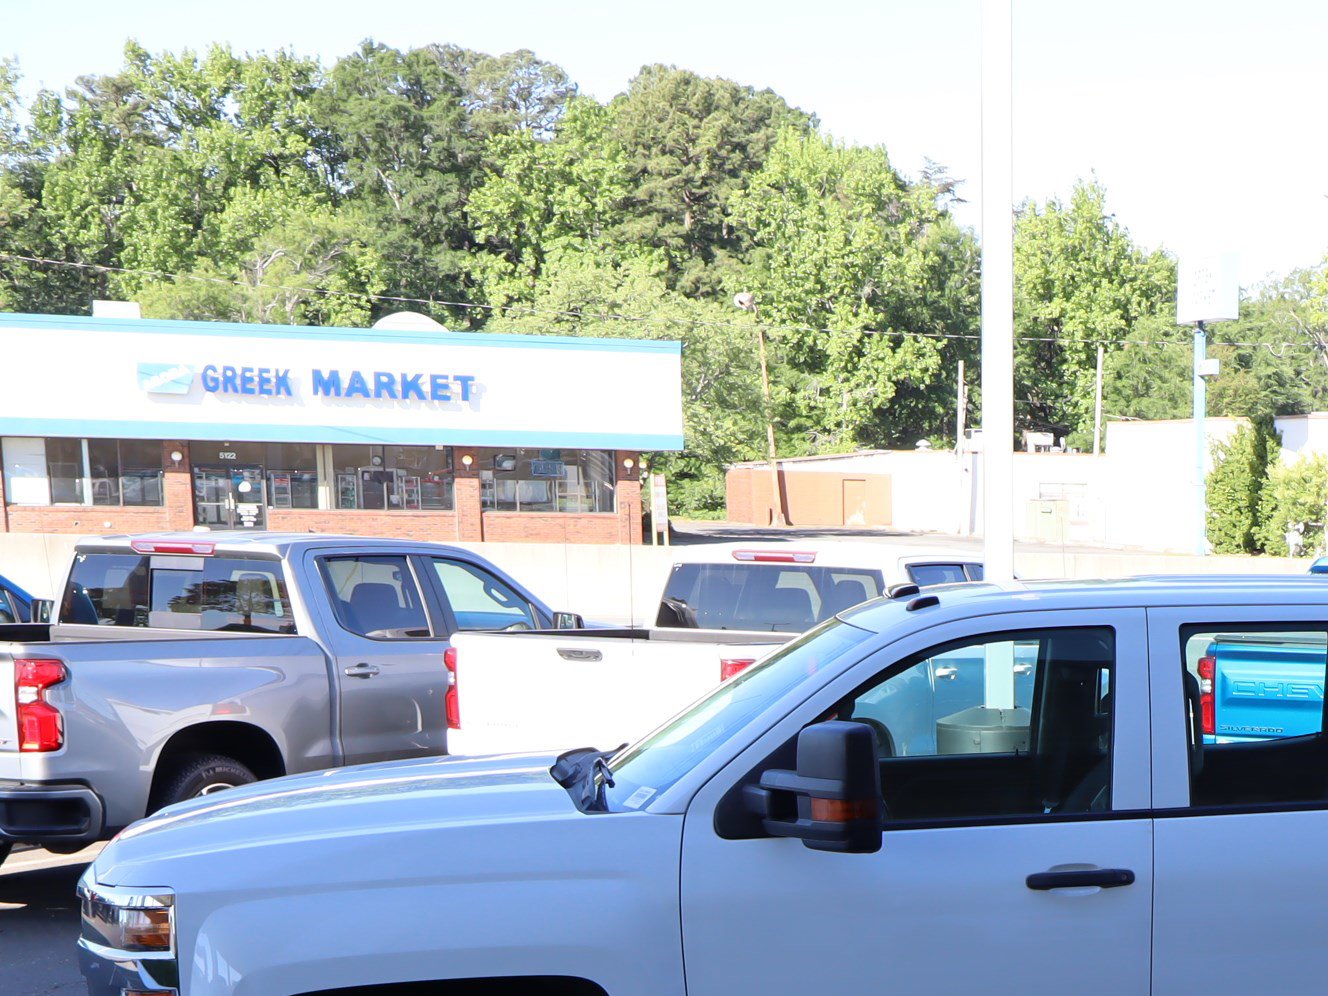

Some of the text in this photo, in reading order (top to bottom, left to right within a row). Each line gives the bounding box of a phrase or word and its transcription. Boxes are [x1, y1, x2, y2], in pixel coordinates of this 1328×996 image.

[201, 364, 293, 397] GREEK
[312, 368, 476, 402] MARKET
[219, 452, 237, 460] 5122
